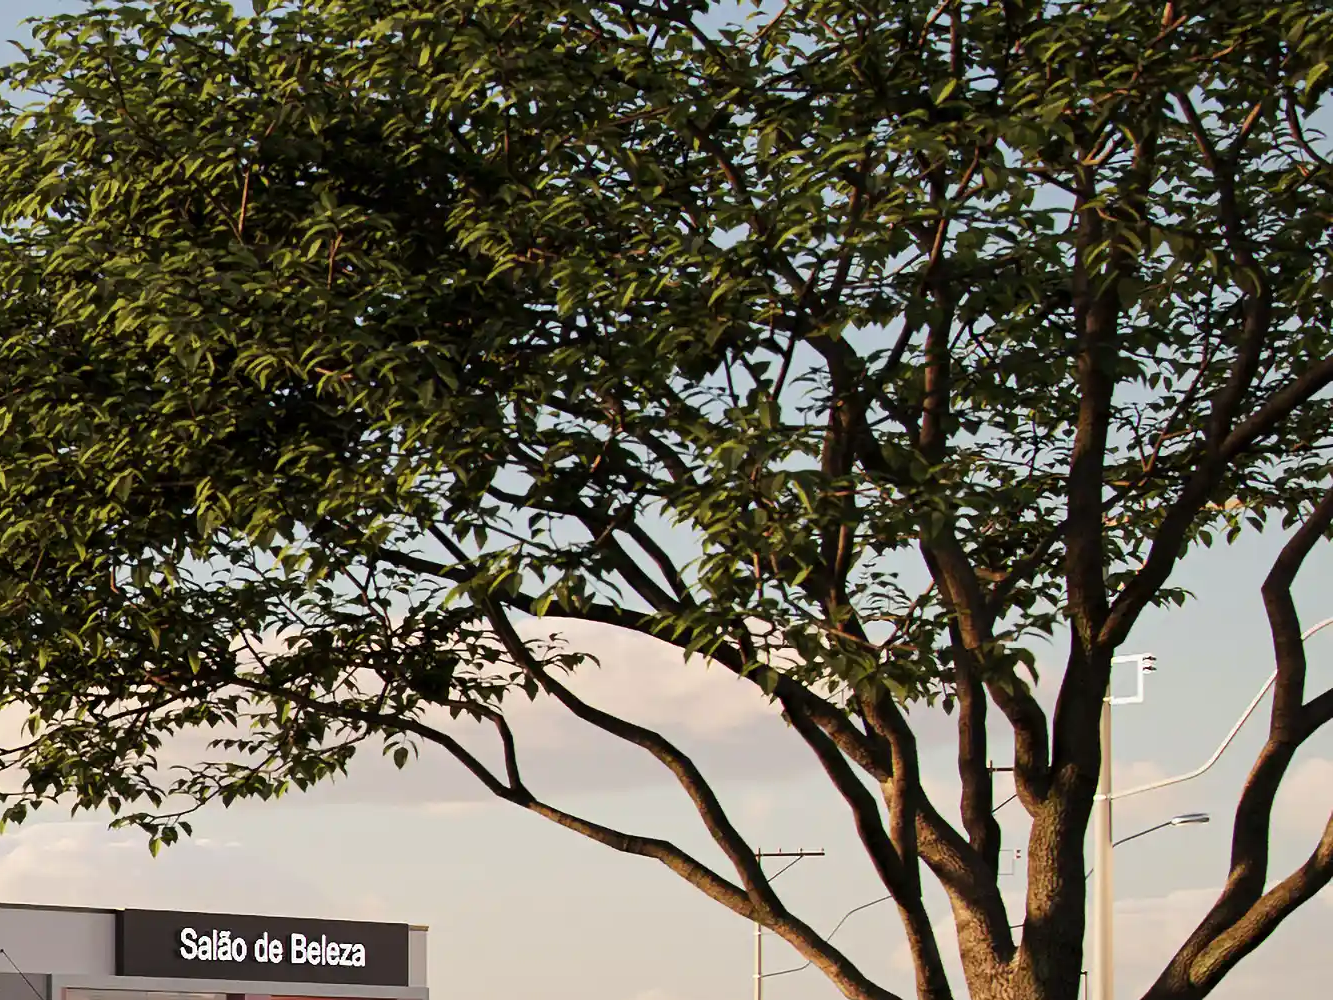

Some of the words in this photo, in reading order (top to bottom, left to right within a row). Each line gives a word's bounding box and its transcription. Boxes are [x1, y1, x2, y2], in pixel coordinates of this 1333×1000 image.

[179, 927, 248, 963] Salão
[253, 931, 283, 963] de
[290, 932, 366, 967] Beleza
